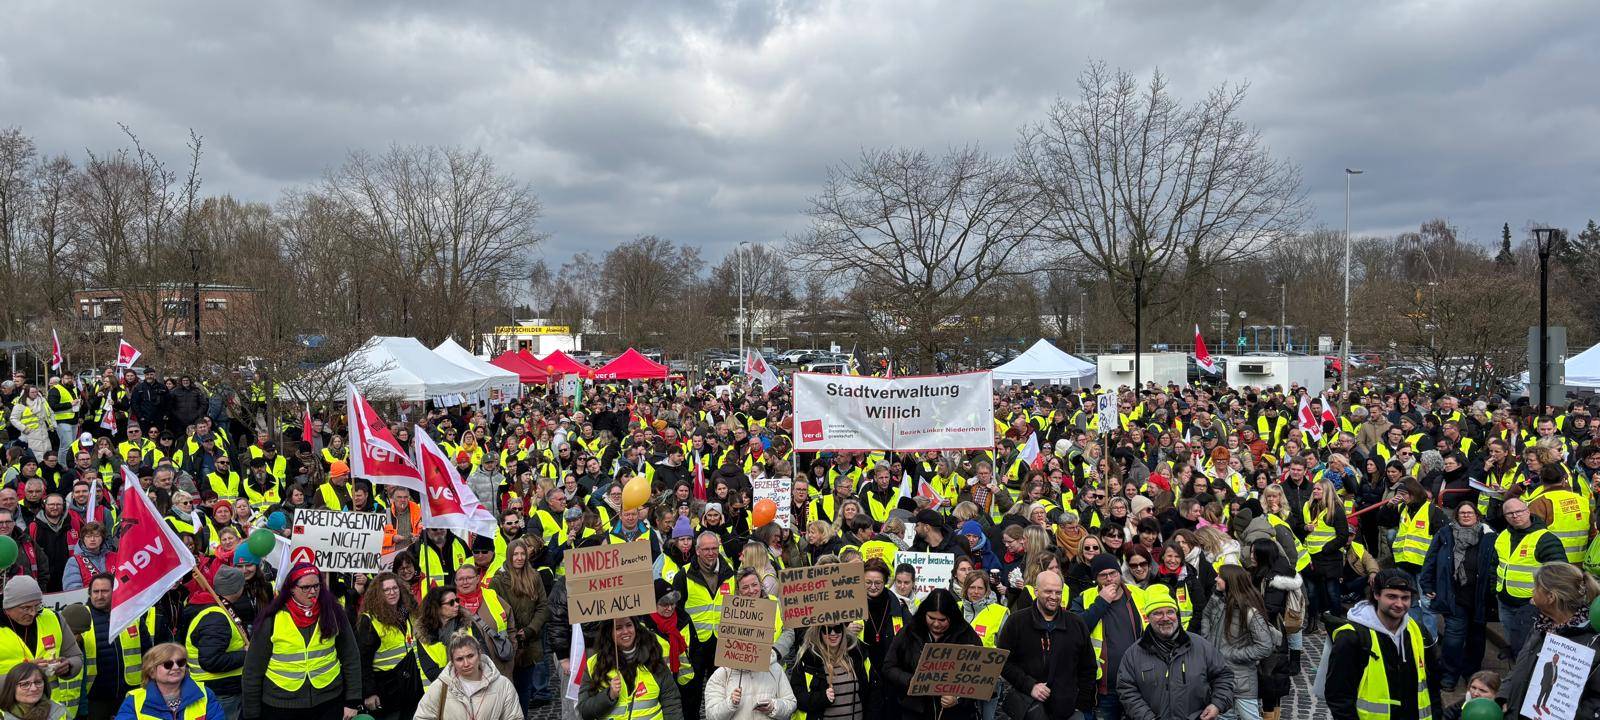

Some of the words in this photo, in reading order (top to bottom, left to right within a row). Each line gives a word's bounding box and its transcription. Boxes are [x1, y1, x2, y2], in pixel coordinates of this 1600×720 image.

[826, 382, 960, 399] Stadtverwaltung
[865, 405, 920, 419] Willich
[295, 510, 387, 531] ARBEITSAGENTUR
[330, 532, 370, 550] NICHT
[572, 548, 619, 575] KINDER
[621, 554, 648, 566] brauchen
[896, 553, 926, 565] Kinder
[781, 569, 803, 583] MIT
[807, 566, 840, 579] EINEM
[588, 575, 624, 591] KNETE
[782, 579, 828, 595] ANGEBOT
[831, 575, 860, 587] WÄRE
[576, 599, 607, 616] WIR
[610, 593, 641, 612] AUCH
[732, 597, 755, 608] GUTE
[784, 596, 799, 606] ICH
[803, 591, 830, 603] HEUTE
[834, 589, 855, 599] ZUR
[723, 607, 764, 621] BILDUNG
[784, 606, 815, 621] ARBEIT
[801, 608, 864, 626] GEGANGEN
[738, 627, 754, 637] NICHT
[756, 629, 765, 639] IM
[724, 650, 759, 664] ANGEBOT
[926, 647, 952, 660] ICH
[957, 648, 982, 661] BIN
[982, 651, 1004, 664] SO
[920, 661, 955, 672] SAUER
[960, 662, 982, 673] ICH
[916, 672, 949, 682] HABE
[952, 673, 994, 685] SOGAR
[912, 684, 930, 694] EIN
[934, 684, 976, 695] SCHILD
